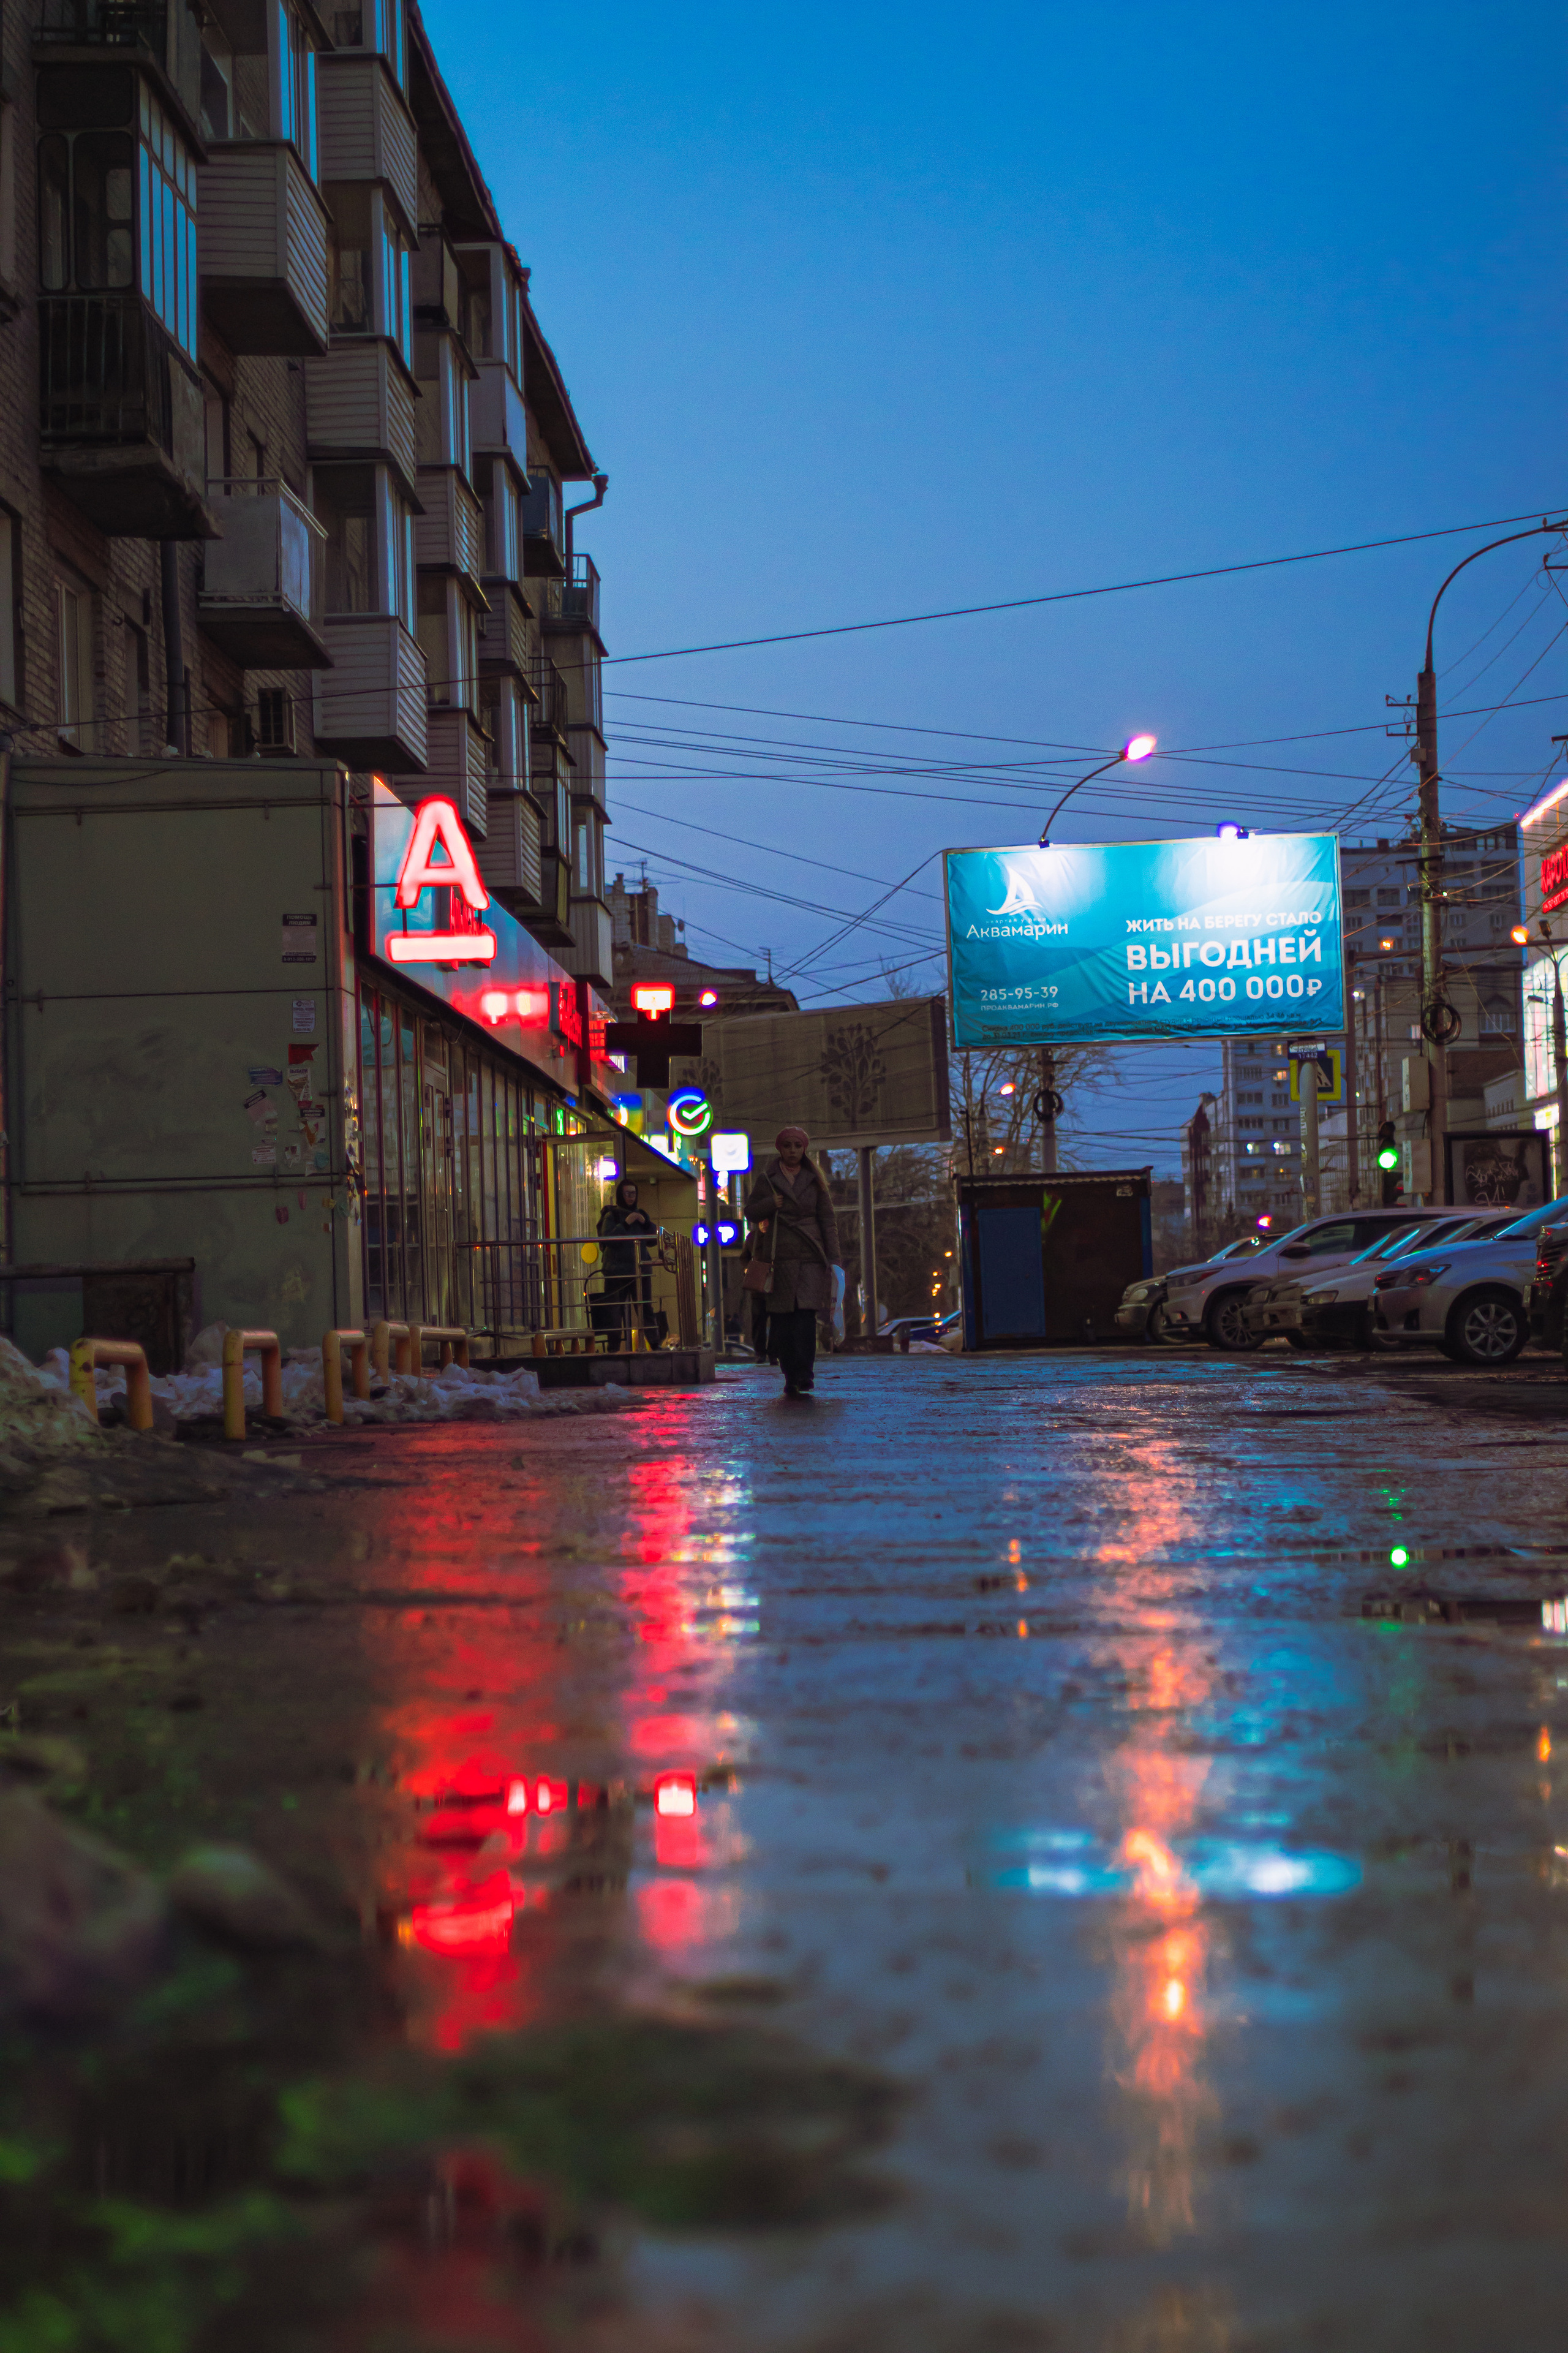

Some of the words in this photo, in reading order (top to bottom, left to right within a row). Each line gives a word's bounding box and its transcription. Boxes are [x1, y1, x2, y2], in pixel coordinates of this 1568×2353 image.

[966, 923, 1068, 940] Аквамарин
[1126, 918, 1174, 932] ЖИТЬ
[1178, 917, 1201, 930] НА
[1204, 913, 1262, 929] БЕРЕГУ
[1265, 911, 1322, 926] СТАЛО
[1126, 929, 1322, 970] ВЫГОДНЕЙ
[981, 986, 1058, 1001] 285-95-39
[1128, 981, 1172, 1005] НА
[1179, 976, 1236, 1002] 400
